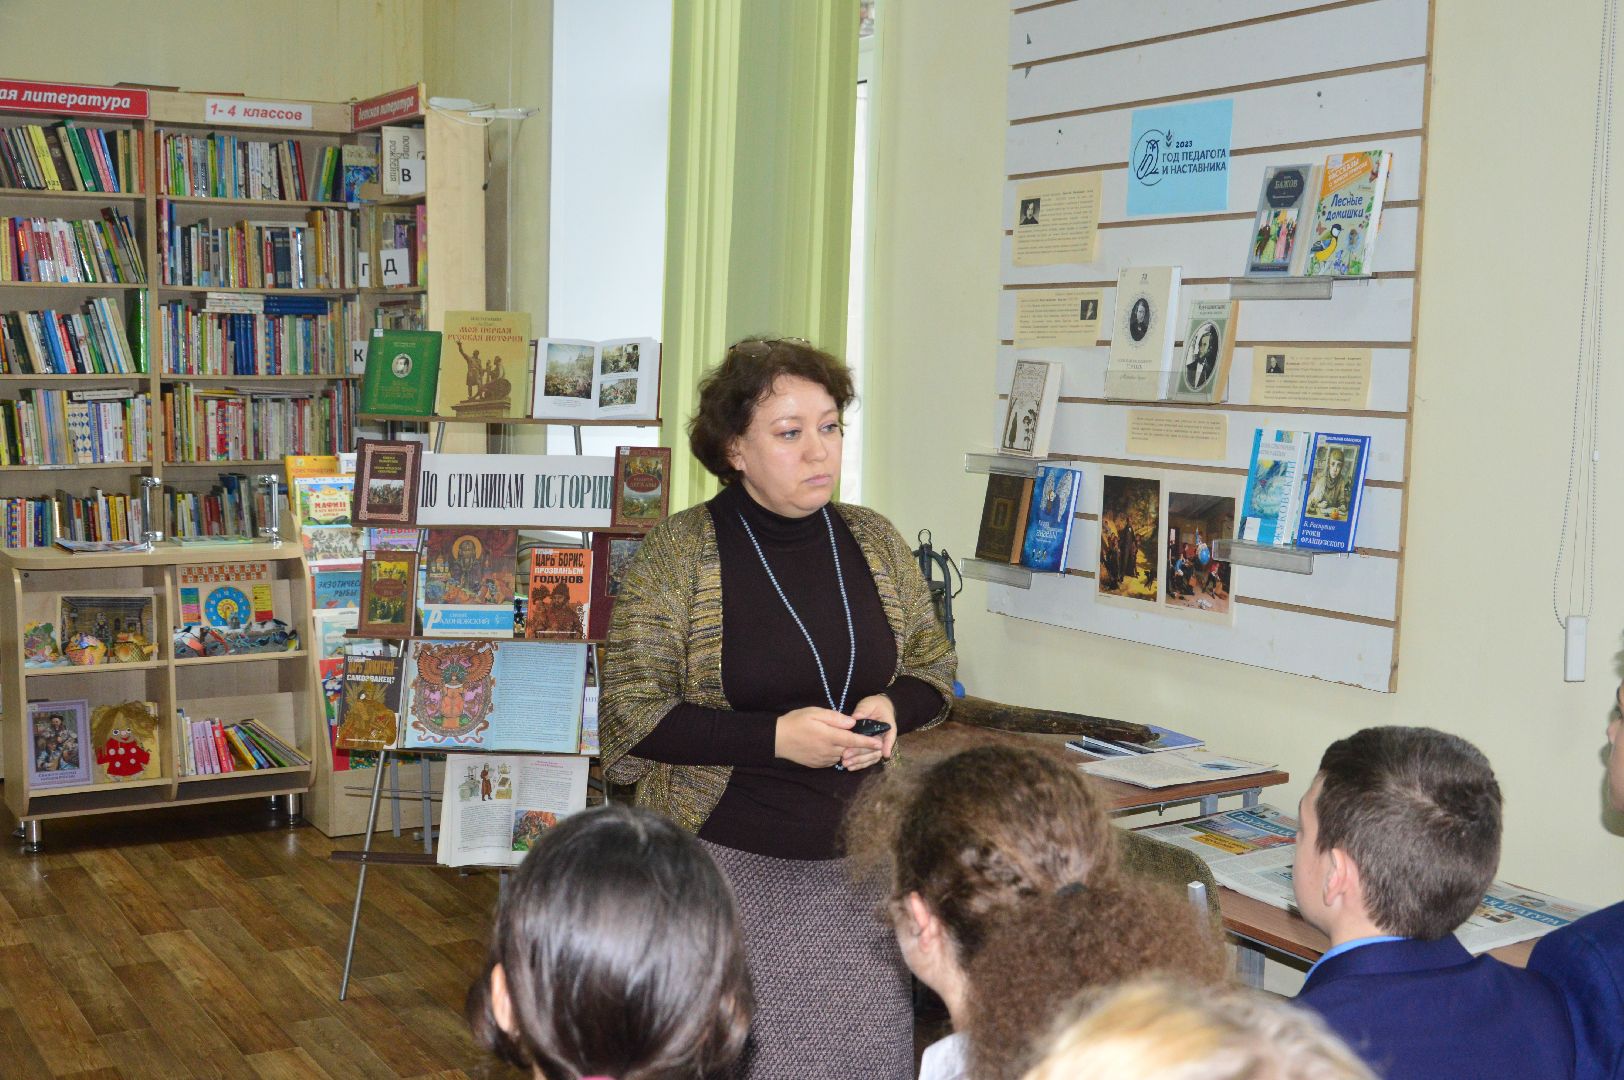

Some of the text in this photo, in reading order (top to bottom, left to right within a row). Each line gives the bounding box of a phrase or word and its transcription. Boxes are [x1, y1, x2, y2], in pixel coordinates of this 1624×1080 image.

[21, 89, 131, 111] литература
[227, 105, 237, 117] 4
[243, 106, 303, 120] классов
[1175, 140, 1193, 149] 2023
[1162, 148, 1227, 163] ГОД ПЕДАГОГА
[401, 169, 412, 182] В
[1162, 161, 1226, 175] И НАСТАВНИКА
[1331, 193, 1363, 208] Лесные
[383, 258, 398, 275] Д
[353, 348, 364, 362] К
[447, 473, 525, 510] СТРАНИЦАМ
[533, 474, 615, 509] ИСТОРИИ
[535, 553, 556, 568] ЦАРЬ
[533, 575, 584, 584] ГОДУНОВ
